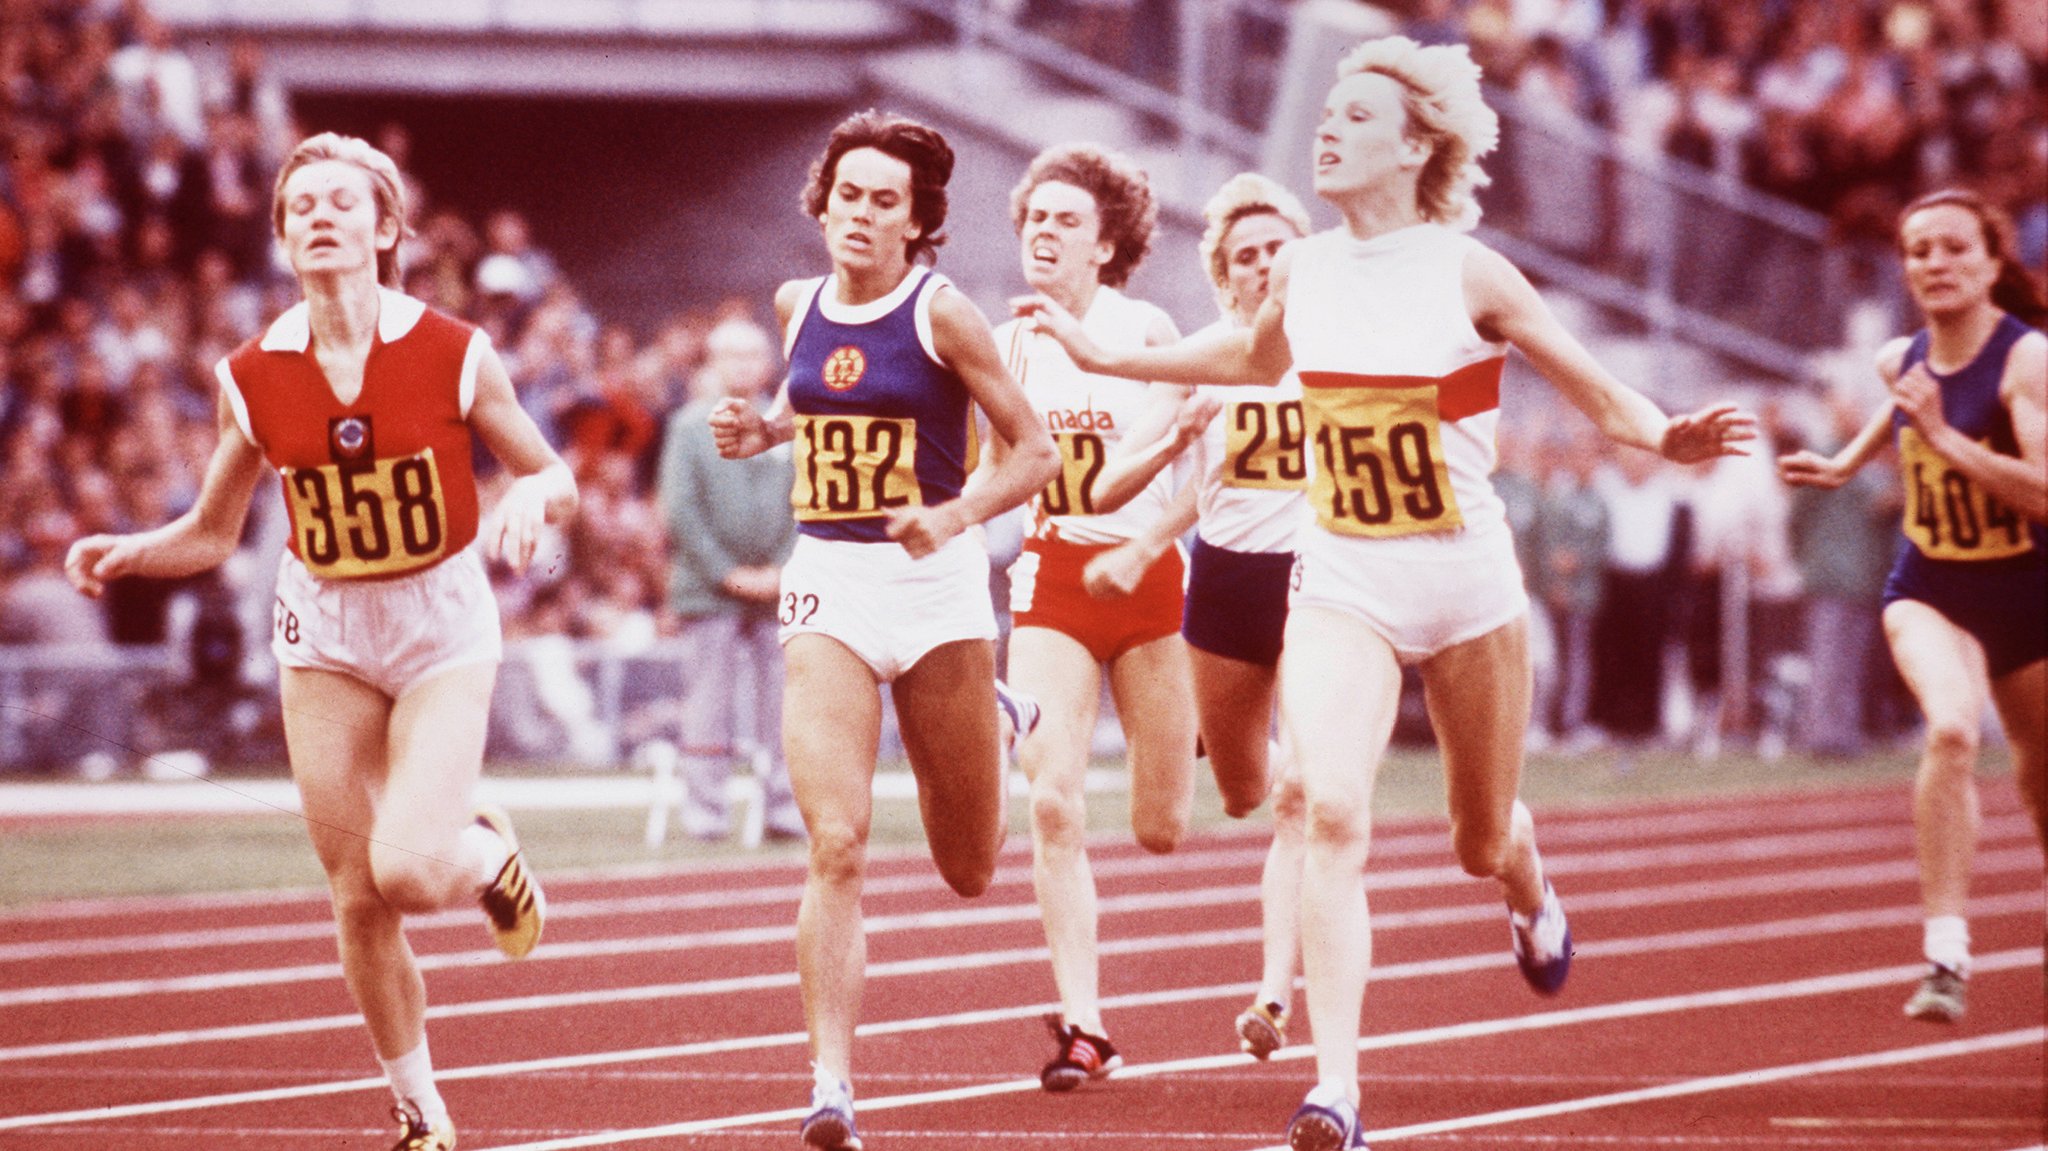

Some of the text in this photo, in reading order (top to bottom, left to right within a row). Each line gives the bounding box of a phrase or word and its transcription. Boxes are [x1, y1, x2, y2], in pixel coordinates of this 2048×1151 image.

[293, 457, 441, 565] 358
[805, 420, 909, 512] 132
[1316, 421, 1445, 525] 159
[1914, 462, 2021, 549] 404
